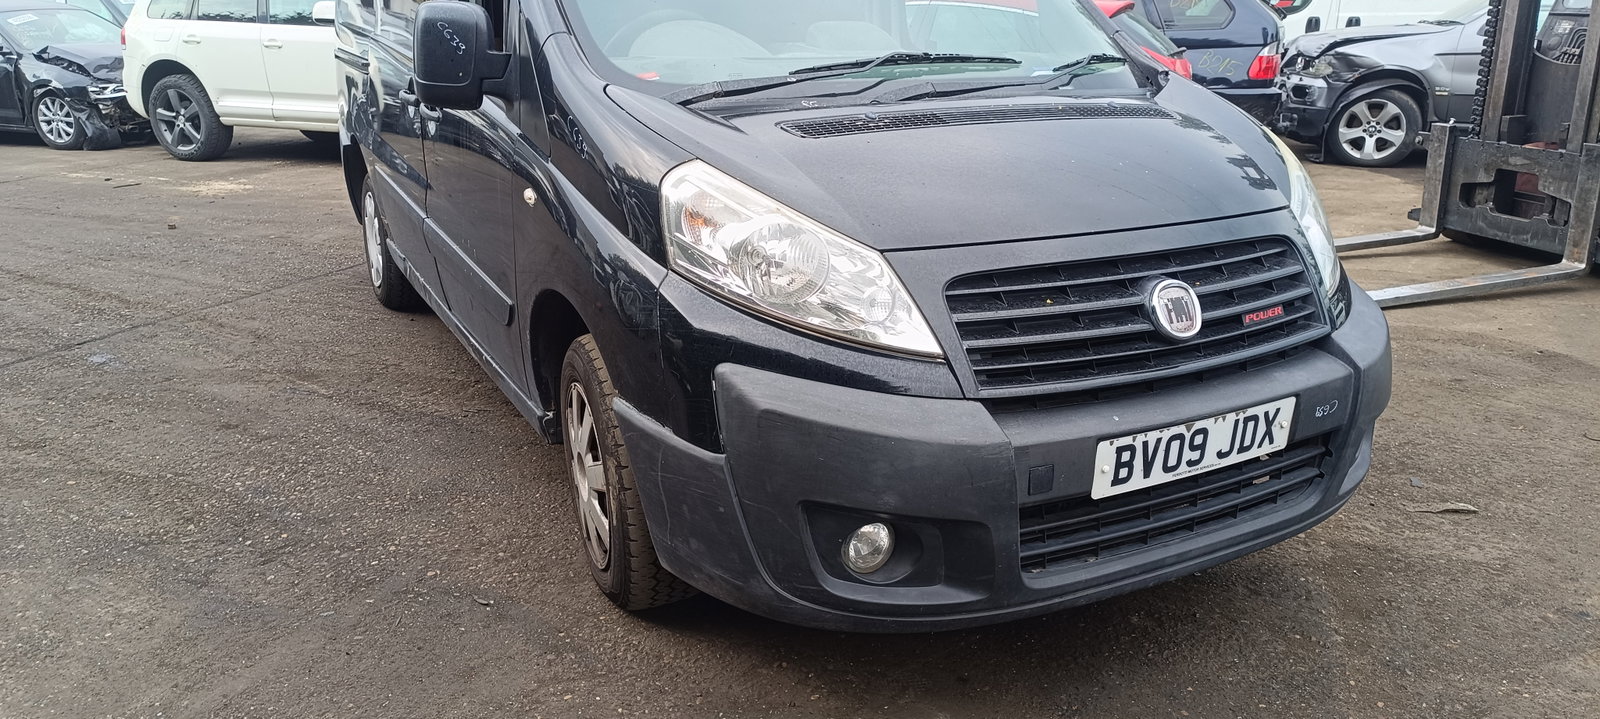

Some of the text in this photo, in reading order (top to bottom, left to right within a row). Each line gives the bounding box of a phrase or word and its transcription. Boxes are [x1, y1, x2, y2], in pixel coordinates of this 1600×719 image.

[1245, 306, 1282, 323] POWER
[1110, 407, 1281, 487] BV09 JDX
